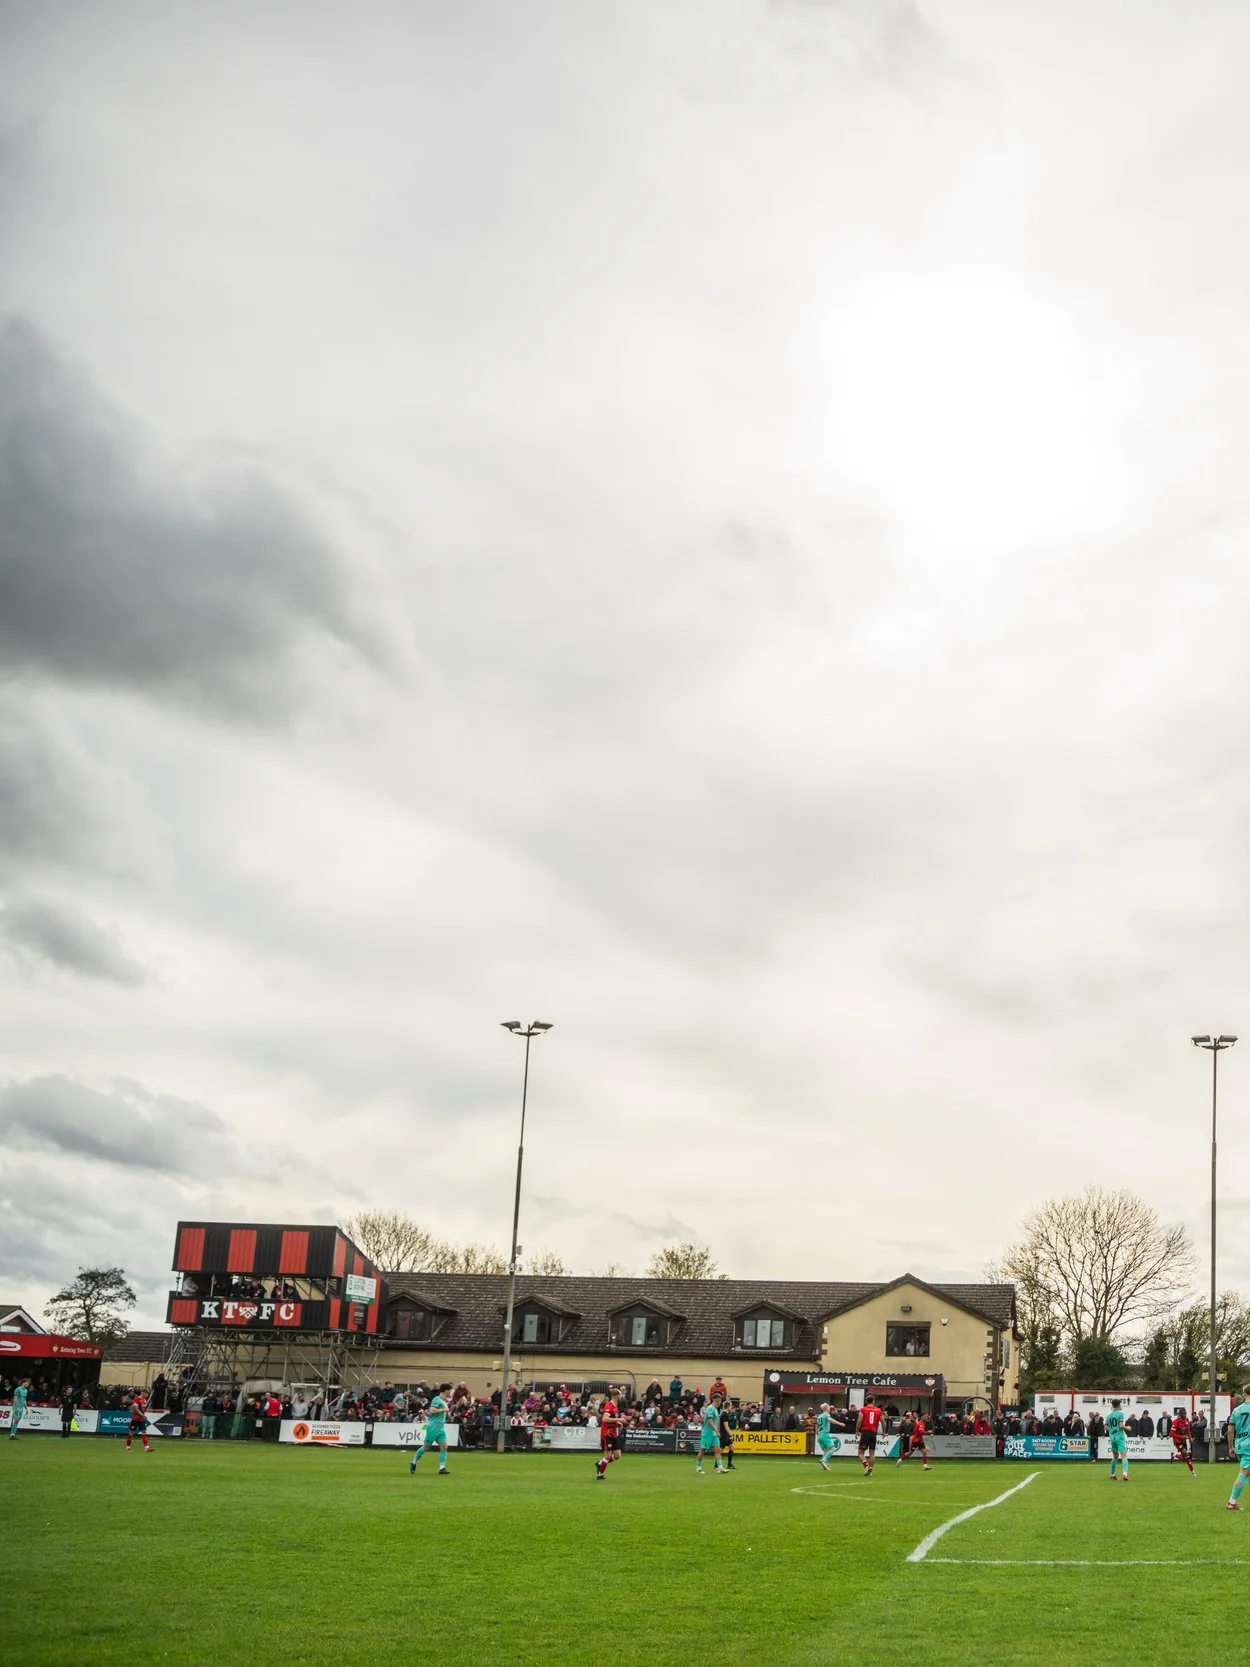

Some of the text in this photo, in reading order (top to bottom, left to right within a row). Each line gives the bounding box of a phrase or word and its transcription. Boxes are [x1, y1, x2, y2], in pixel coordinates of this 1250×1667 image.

[806, 1375, 897, 1386] Lemon Tree Cafe
[1109, 1417, 1118, 1428] 10
[1240, 1412, 1250, 1428] 7
[748, 1434, 792, 1443] PALLETS
[1004, 1447, 1032, 1458] SPACE?
